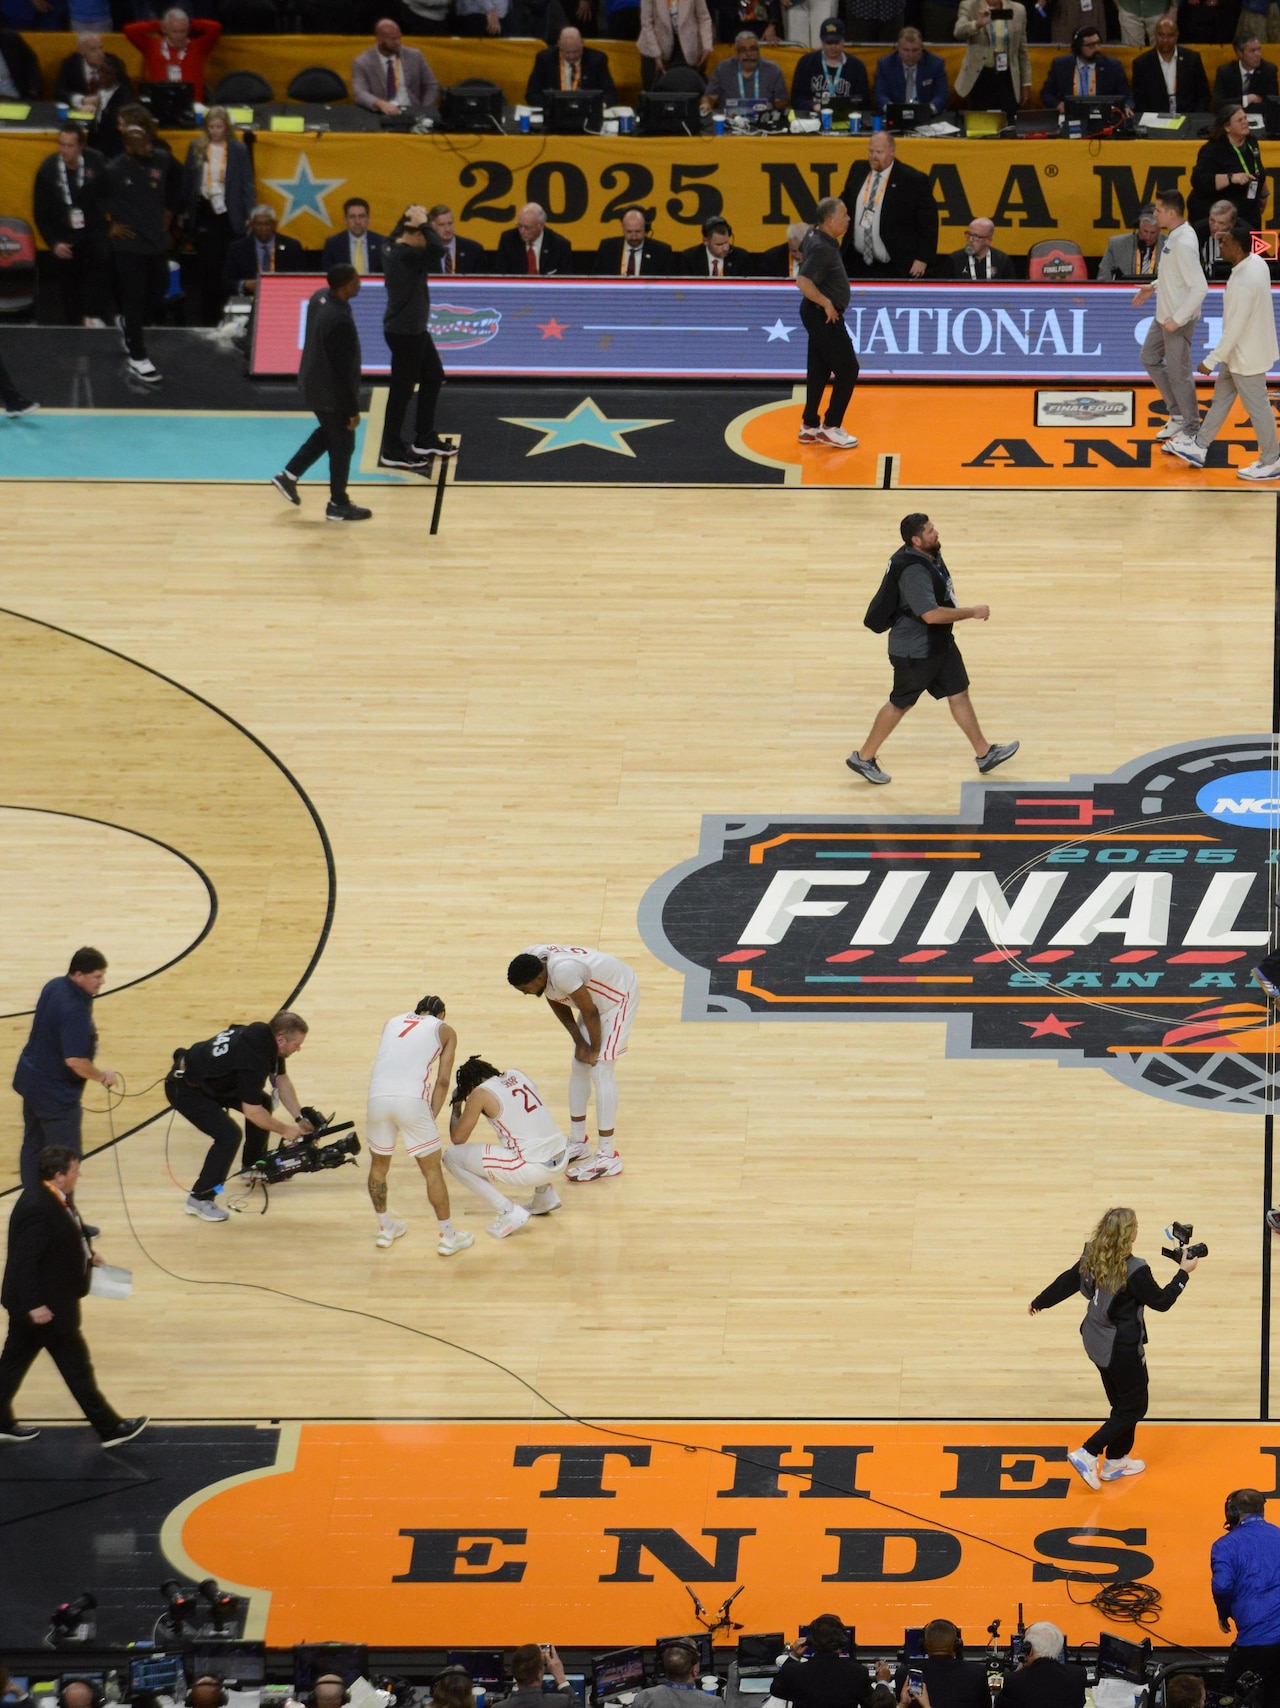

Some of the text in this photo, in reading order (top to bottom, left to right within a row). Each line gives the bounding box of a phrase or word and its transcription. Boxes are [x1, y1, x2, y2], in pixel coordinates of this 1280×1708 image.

[459, 160, 724, 224] 2025
[844, 306, 1102, 356] NATIONAL
[1045, 848, 1237, 864] 2025
[737, 870, 1272, 946] FINAL
[1007, 971, 1165, 988] SAN
[398, 1020, 419, 1038] 7
[511, 1083, 544, 1114] 21
[512, 1444, 1073, 1499] THE
[391, 1526, 1155, 1583] ENDS
